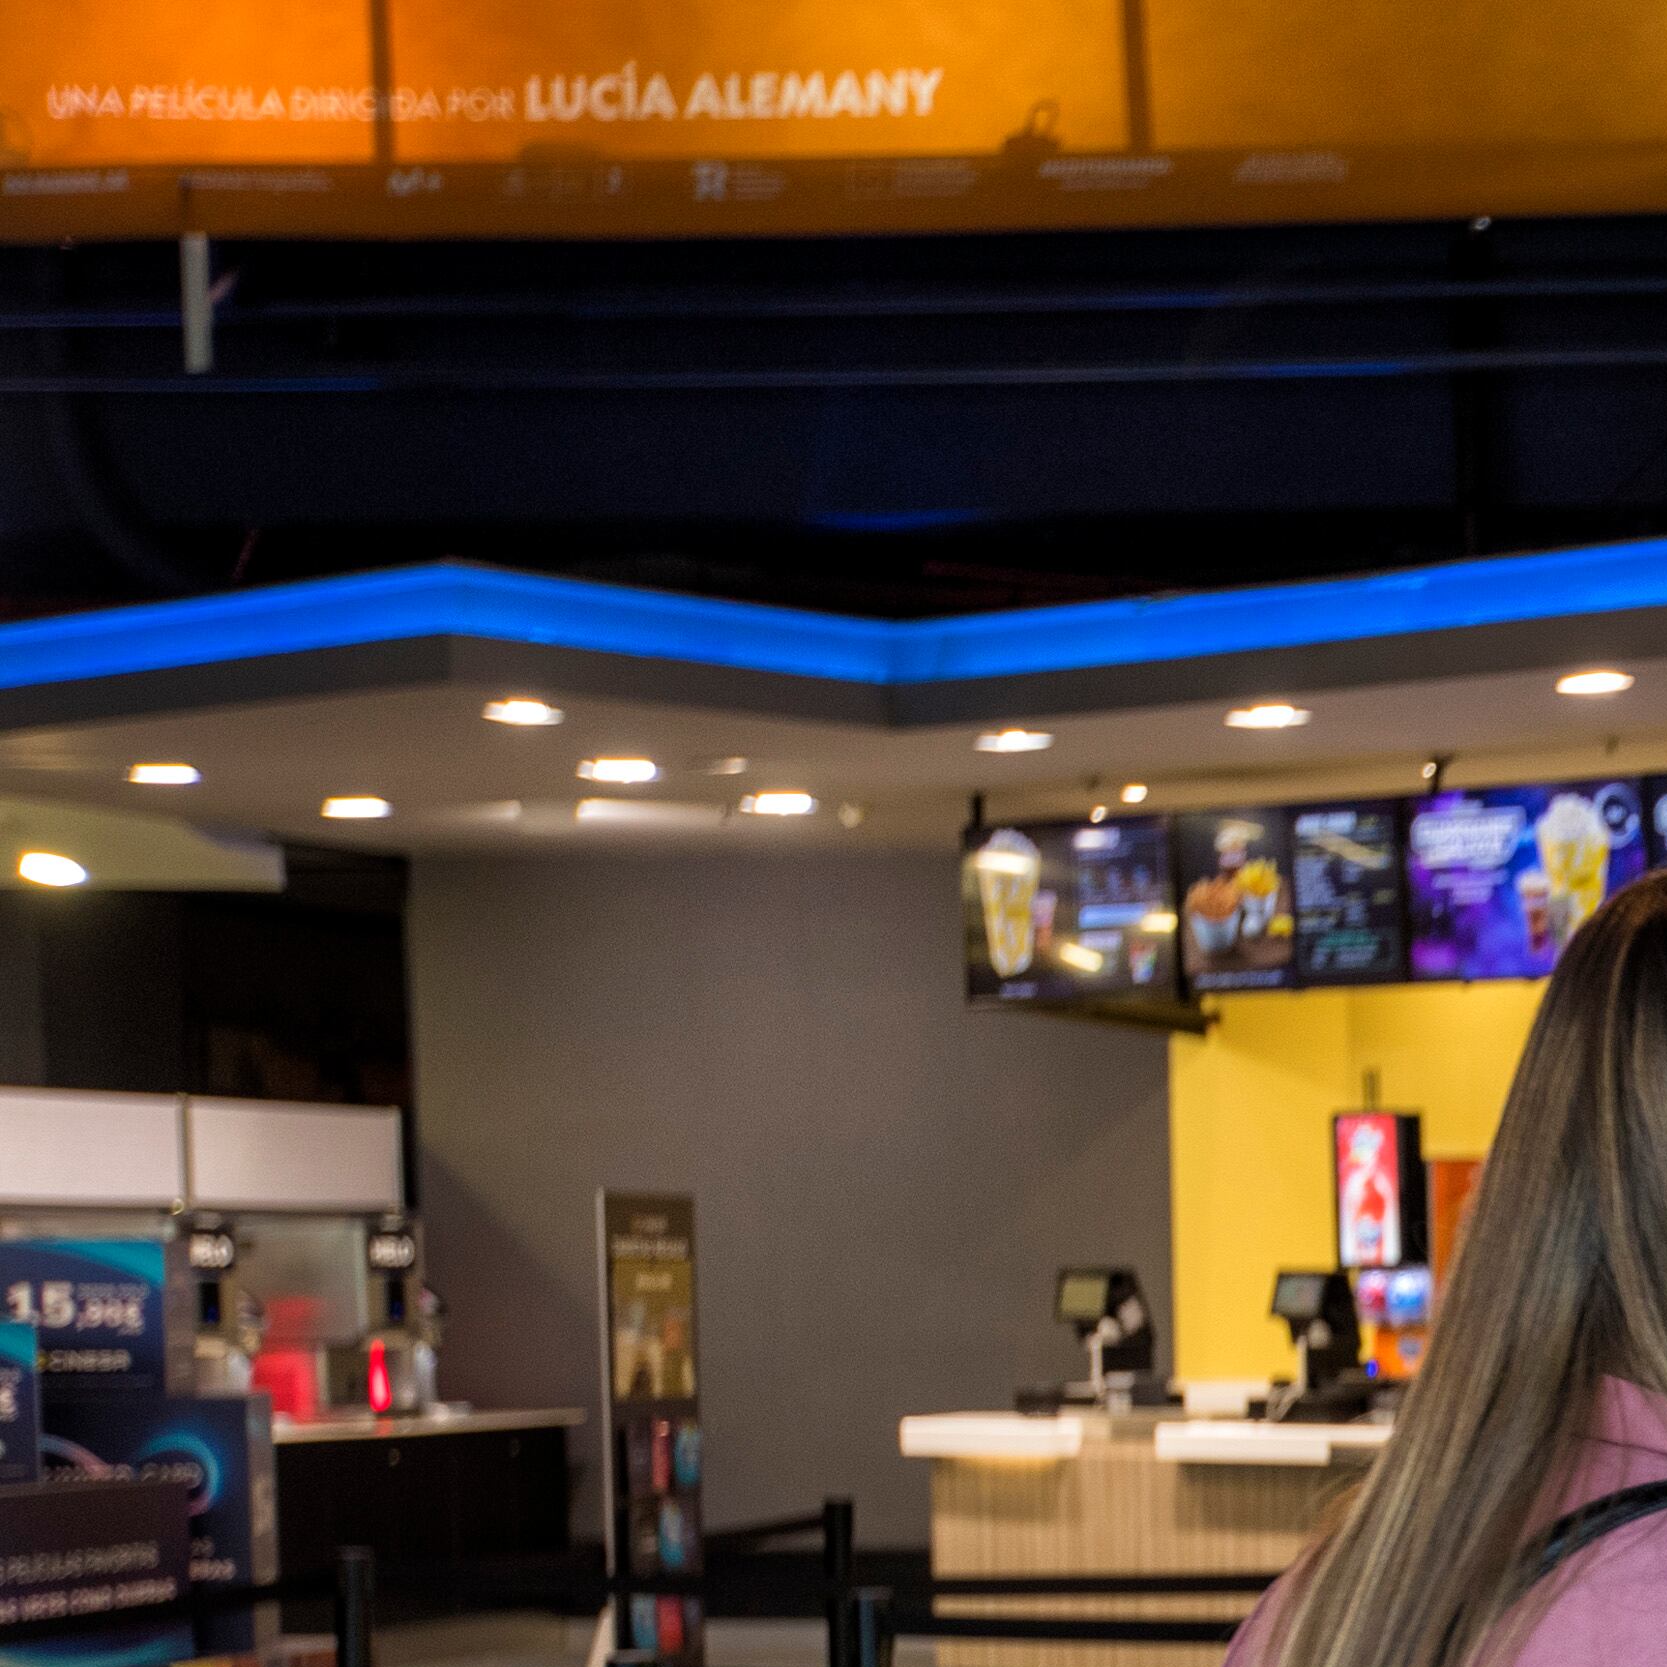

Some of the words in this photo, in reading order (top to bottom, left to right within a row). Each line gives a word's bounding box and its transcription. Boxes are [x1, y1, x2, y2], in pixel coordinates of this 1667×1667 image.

[47, 84, 123, 119] UNA
[129, 77, 286, 120] PELÍCULA
[448, 86, 513, 122] POR
[524, 60, 678, 122] LUCÍA
[684, 67, 943, 120] ALEMANY
